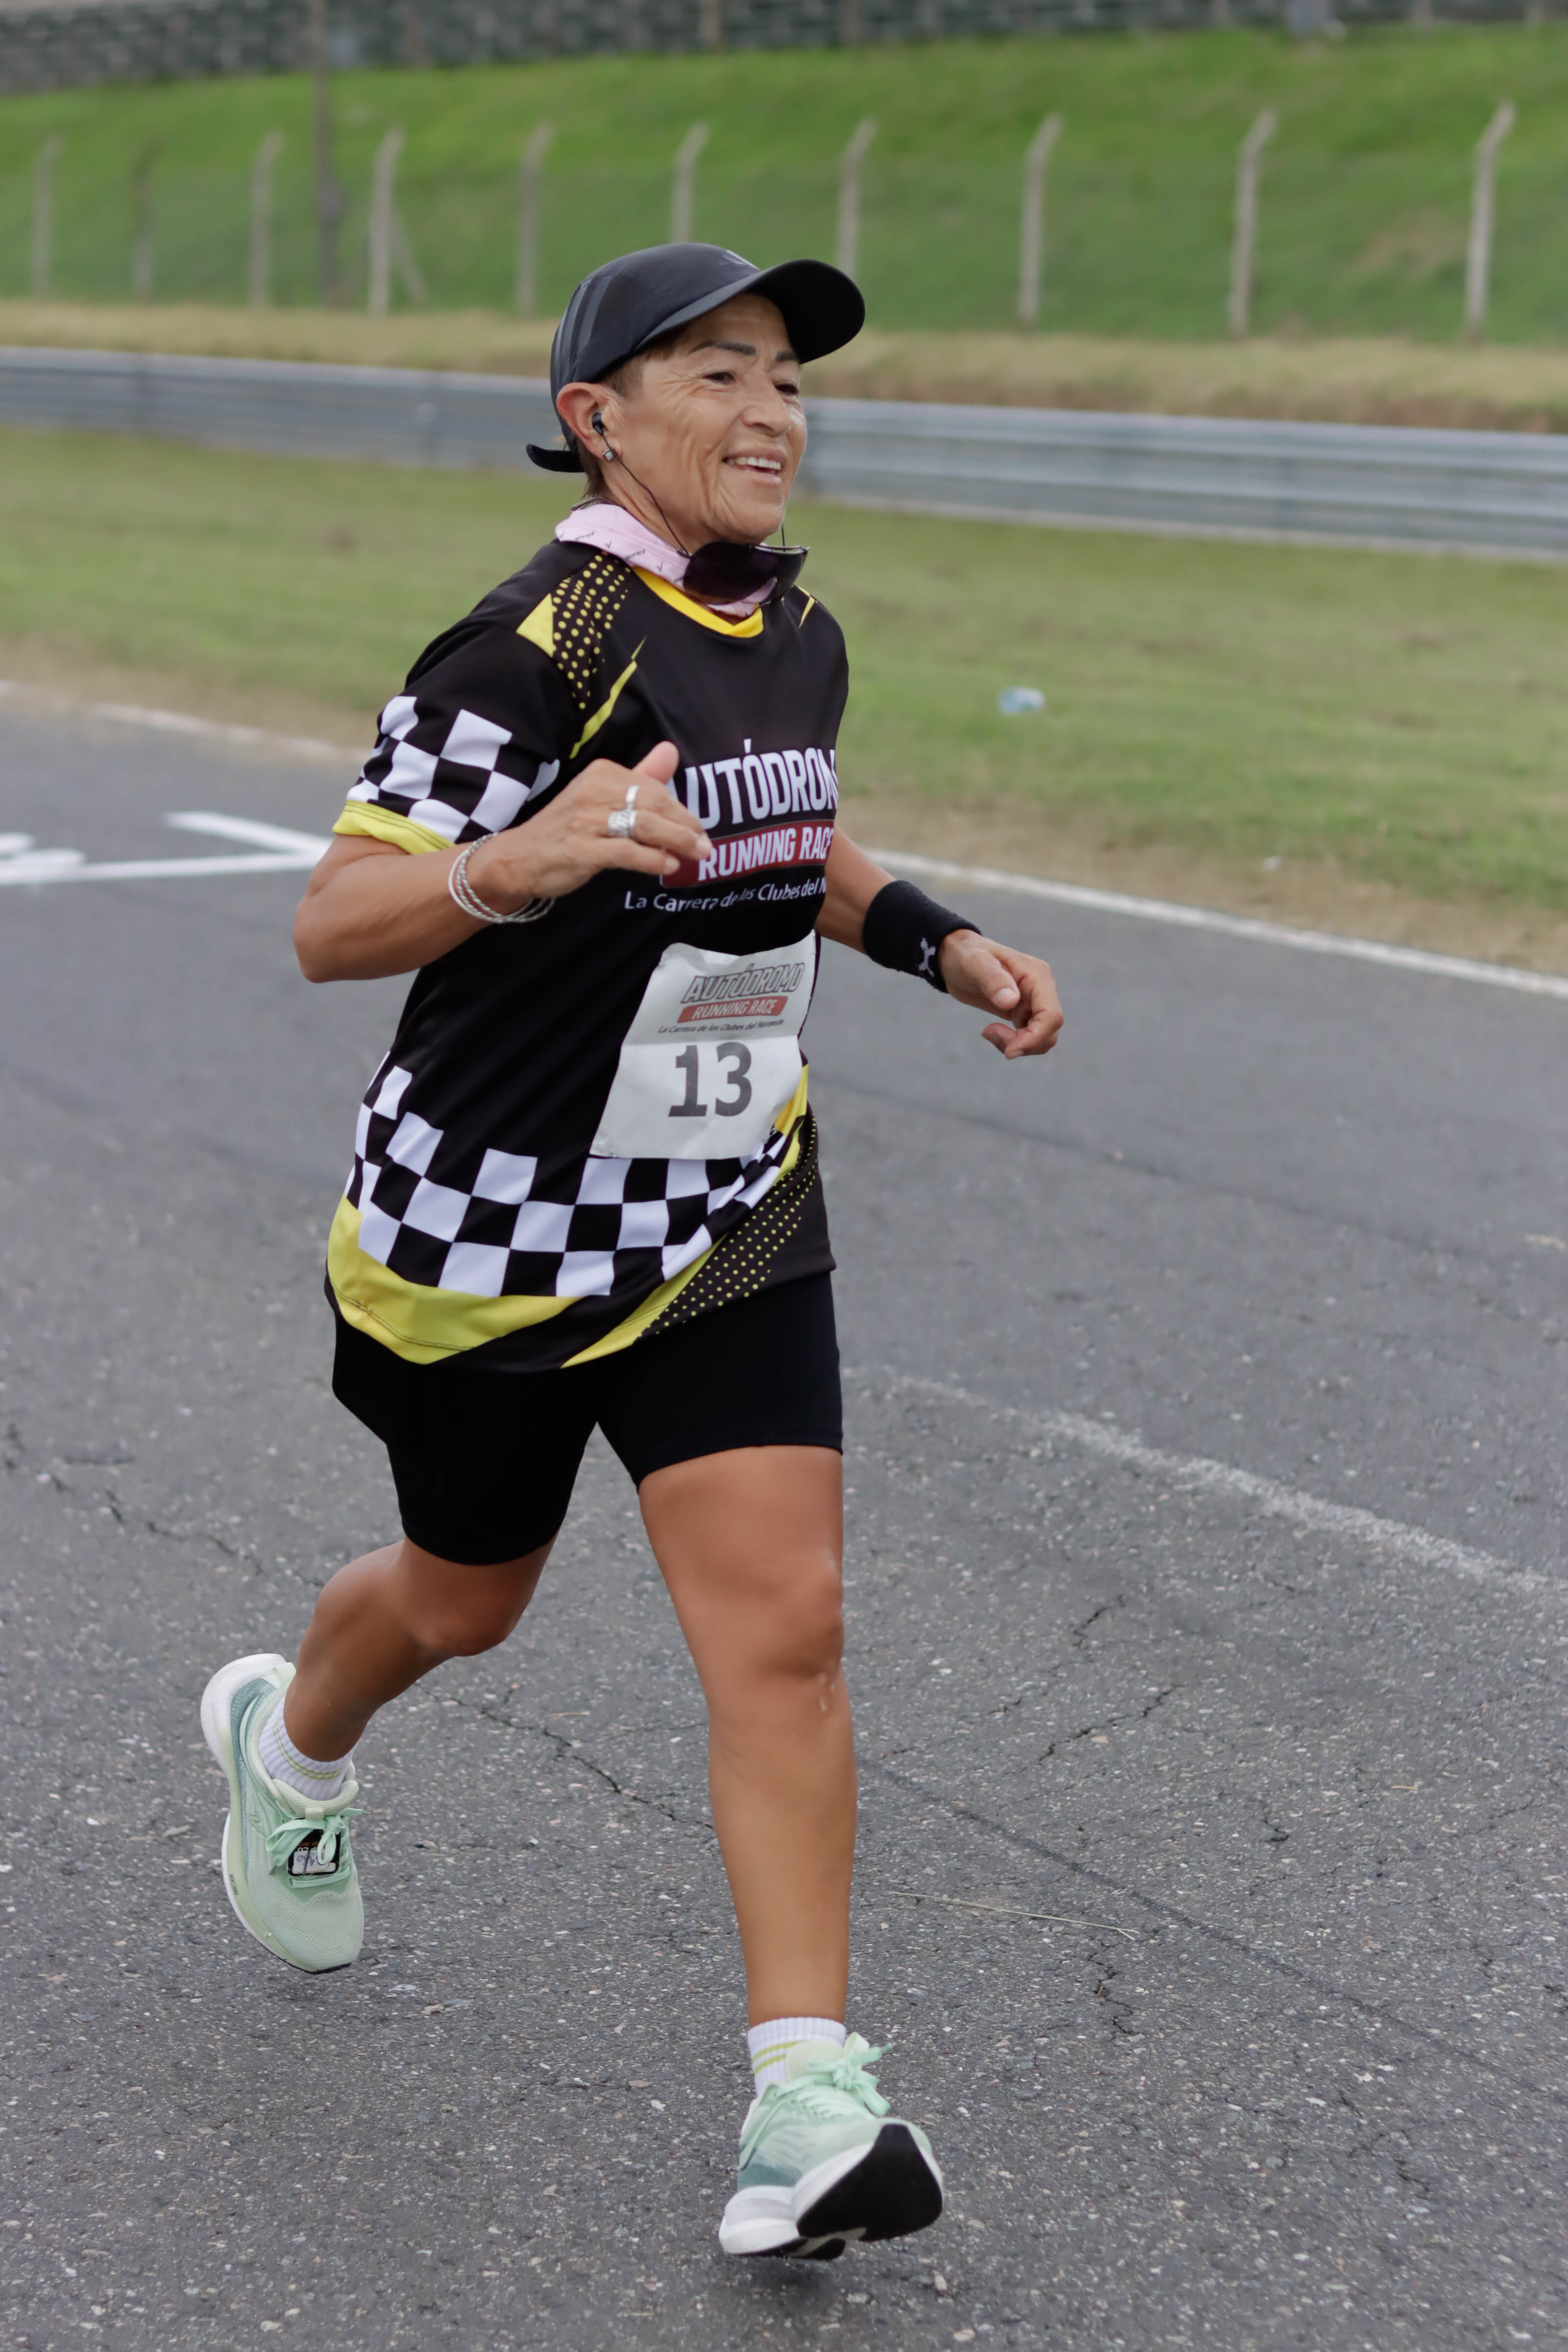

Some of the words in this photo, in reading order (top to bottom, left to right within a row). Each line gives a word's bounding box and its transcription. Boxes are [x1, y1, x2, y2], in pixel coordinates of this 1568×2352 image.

[666, 738, 838, 830] UTÓDROM
[698, 828, 796, 881] RUNNING
[624, 891, 646, 909] La
[758, 883, 801, 901] Clubes
[801, 878, 820, 897] del
[681, 962, 805, 1004] AUTÓDROMO
[691, 1000, 749, 1020] RUNNING
[747, 999, 777, 1014] RACE
[668, 1042, 752, 1117] 13
